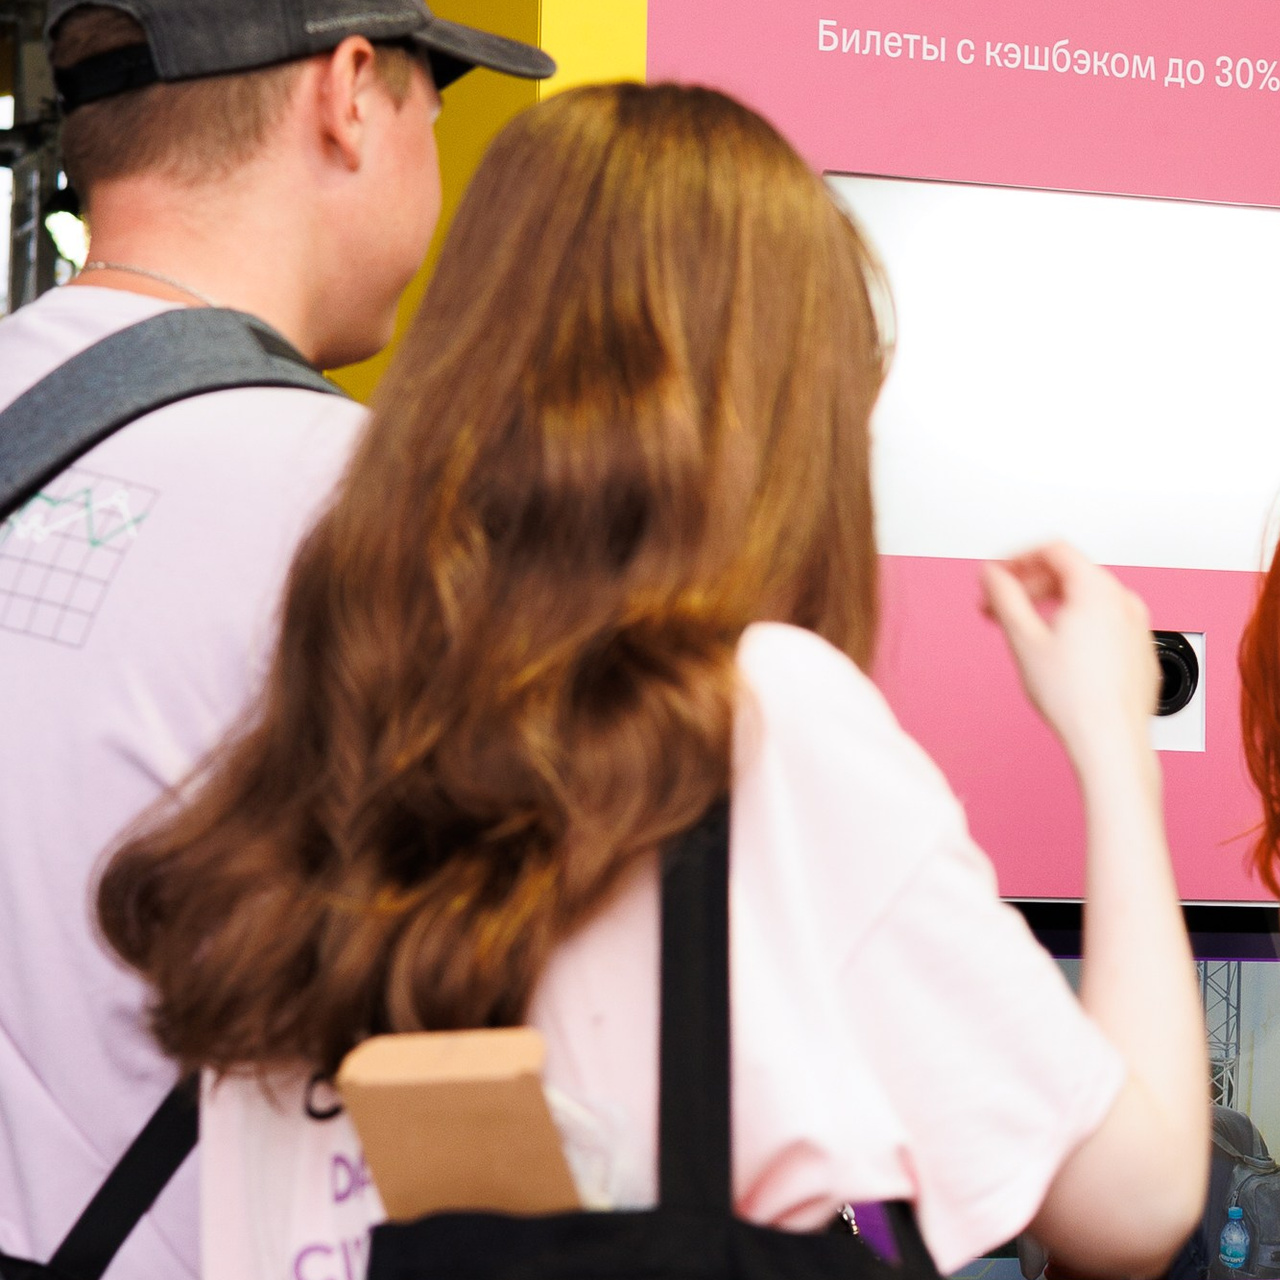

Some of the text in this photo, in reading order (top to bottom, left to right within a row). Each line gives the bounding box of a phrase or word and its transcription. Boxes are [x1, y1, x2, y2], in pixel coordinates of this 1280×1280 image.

[817, 18, 947, 62] Билеты
[956, 38, 976, 65] с
[985, 38, 1157, 81] кэшбэком
[1164, 57, 1206, 89] до
